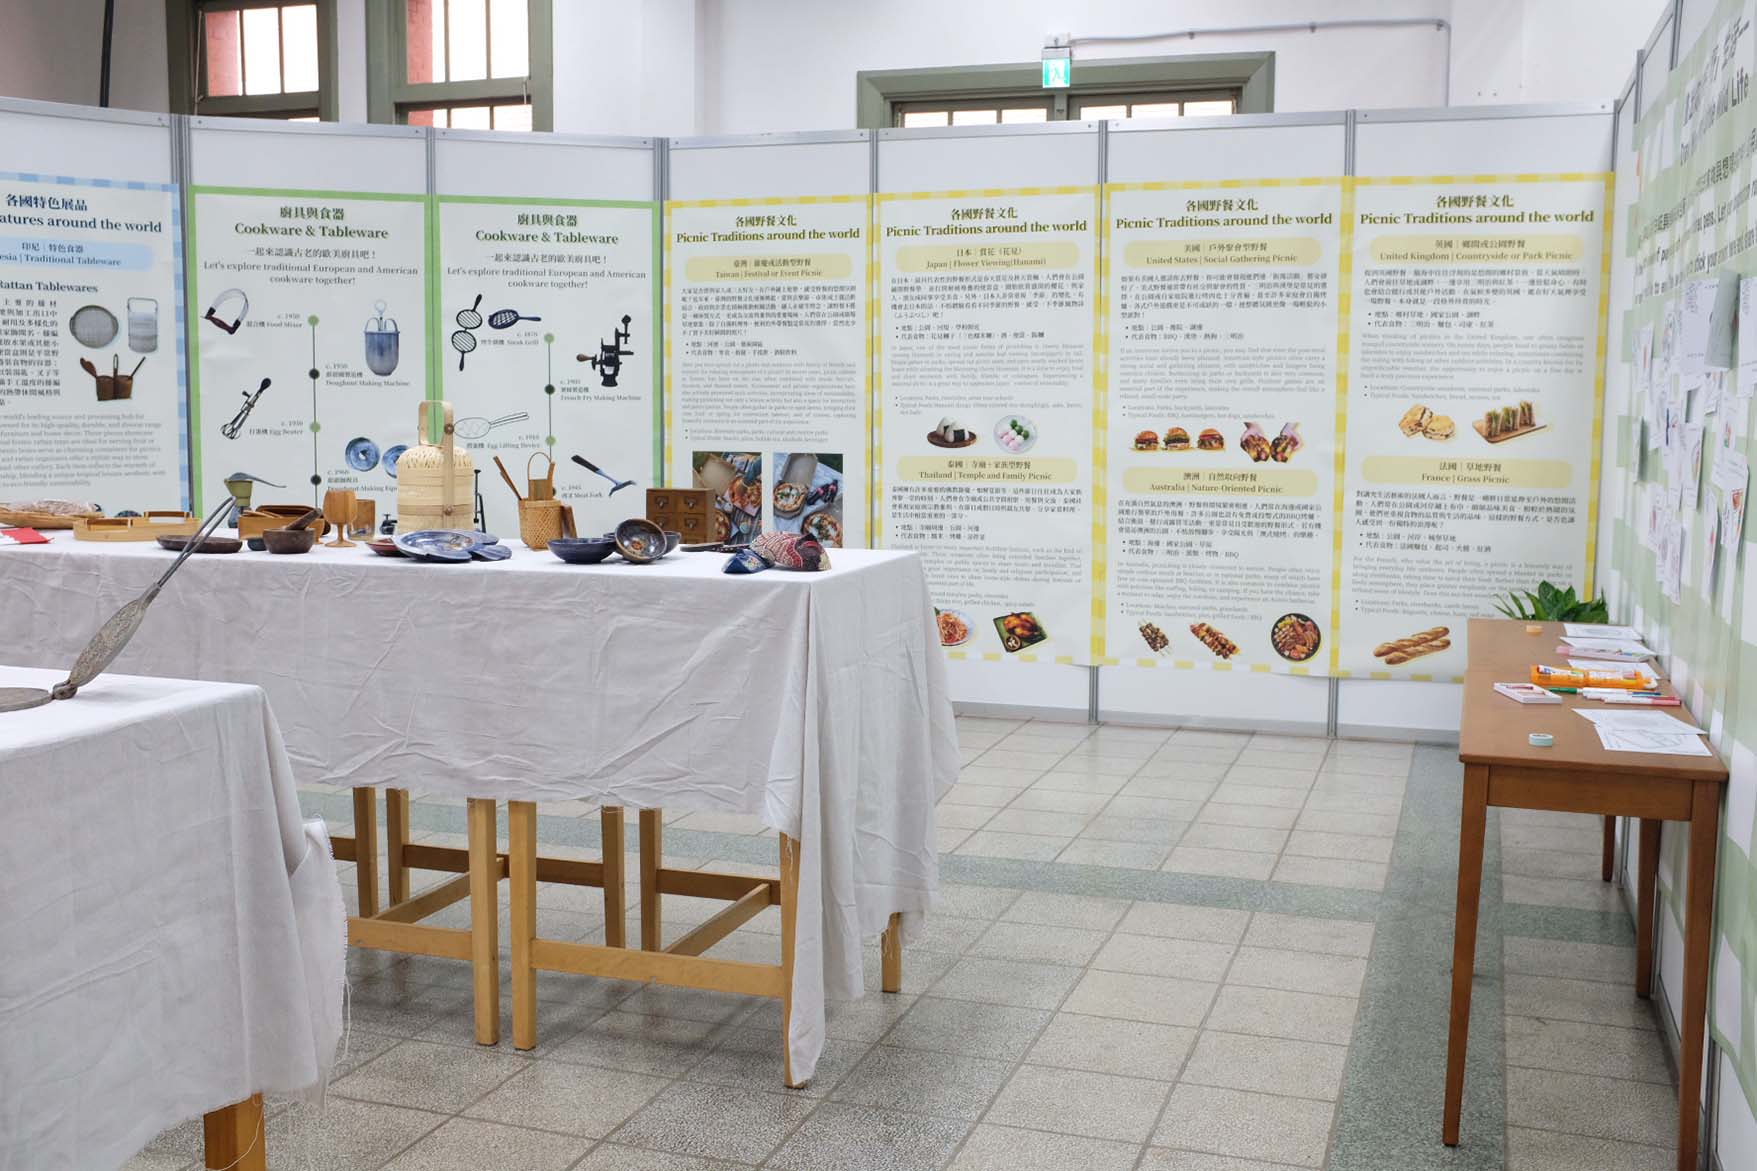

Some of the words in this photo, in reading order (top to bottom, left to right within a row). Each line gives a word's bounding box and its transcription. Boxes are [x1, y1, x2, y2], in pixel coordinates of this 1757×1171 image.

[6, 193, 88, 211] 各國特色展品
[1186, 198, 1258, 212] 各國野餐文化
[1436, 195, 1514, 209] 各國野餐文化
[280, 206, 345, 221] 廚具與食器
[951, 207, 1018, 220] 各國野餐文化
[1360, 214, 1400, 225] Picnic
[1403, 212, 1472, 224] Traditions
[1476, 211, 1524, 223] around
[1528, 211, 1550, 223] the
[1554, 210, 1594, 222] world
[47, 217, 97, 229] around
[100, 220, 122, 230] the
[125, 221, 162, 233] world
[518, 214, 578, 227] 廚具與食器
[736, 215, 797, 228] 各國野餐文化
[1116, 218, 1153, 229] Picnic
[1156, 216, 1220, 228] Traditions
[1223, 214, 1268, 226] around
[1272, 214, 1293, 225] the
[1296, 213, 1332, 224] world
[235, 222, 302, 236] Cookware
[305, 225, 316, 237] &
[319, 226, 389, 239] Tableware
[886, 226, 920, 237] Picnic
[923, 224, 983, 236] Traditions
[986, 222, 1027, 234] around
[1030, 221, 1050, 233] the
[1053, 220, 1087, 232] world
[475, 230, 539, 242] Cookware
[542, 232, 551, 243] &
[553, 232, 618, 245] Tableware
[677, 232, 708, 243] Picnic
[711, 230, 764, 242] Traditions
[767, 229, 805, 241] around
[808, 229, 827, 239] the
[829, 228, 860, 239] world
[24, 254, 74, 263] Traditional
[77, 257, 121, 266] Tableware
[1147, 257, 1172, 265] United
[1174, 256, 1197, 264] States
[1204, 255, 1227, 263] Social
[1230, 254, 1270, 264] Gathering
[1272, 254, 1297, 262] Picnic
[1380, 253, 1408, 261] United
[1410, 252, 1449, 262] Kingdom
[1456, 253, 1510, 262] Countryside
[204, 261, 225, 270] Let's
[227, 263, 259, 272] explore
[264, 263, 310, 272] traditional
[313, 264, 355, 274] European
[357, 266, 374, 274] and
[376, 266, 418, 275] American
[926, 261, 948, 270] Japan
[953, 260, 979, 268] Flower
[447, 267, 466, 276] Let's
[468, 268, 498, 277] explore
[502, 268, 546, 277] traditional
[548, 269, 588, 279] European
[589, 270, 605, 278] and
[607, 270, 647, 279] American
[744, 270, 770, 278] Festival
[801, 269, 821, 277] Picnic
[270, 275, 313, 284] cookware
[315, 276, 355, 285] together!
[508, 280, 549, 288] cookware
[551, 281, 588, 289] together!
[35, 282, 98, 293] Tablewares
[958, 472, 985, 480] Temple
[1002, 472, 1026, 481] Family
[1422, 473, 1449, 482] France
[1457, 475, 1480, 483] Grass
[1483, 475, 1510, 484] Picnic
[1150, 483, 1185, 491] Australia
